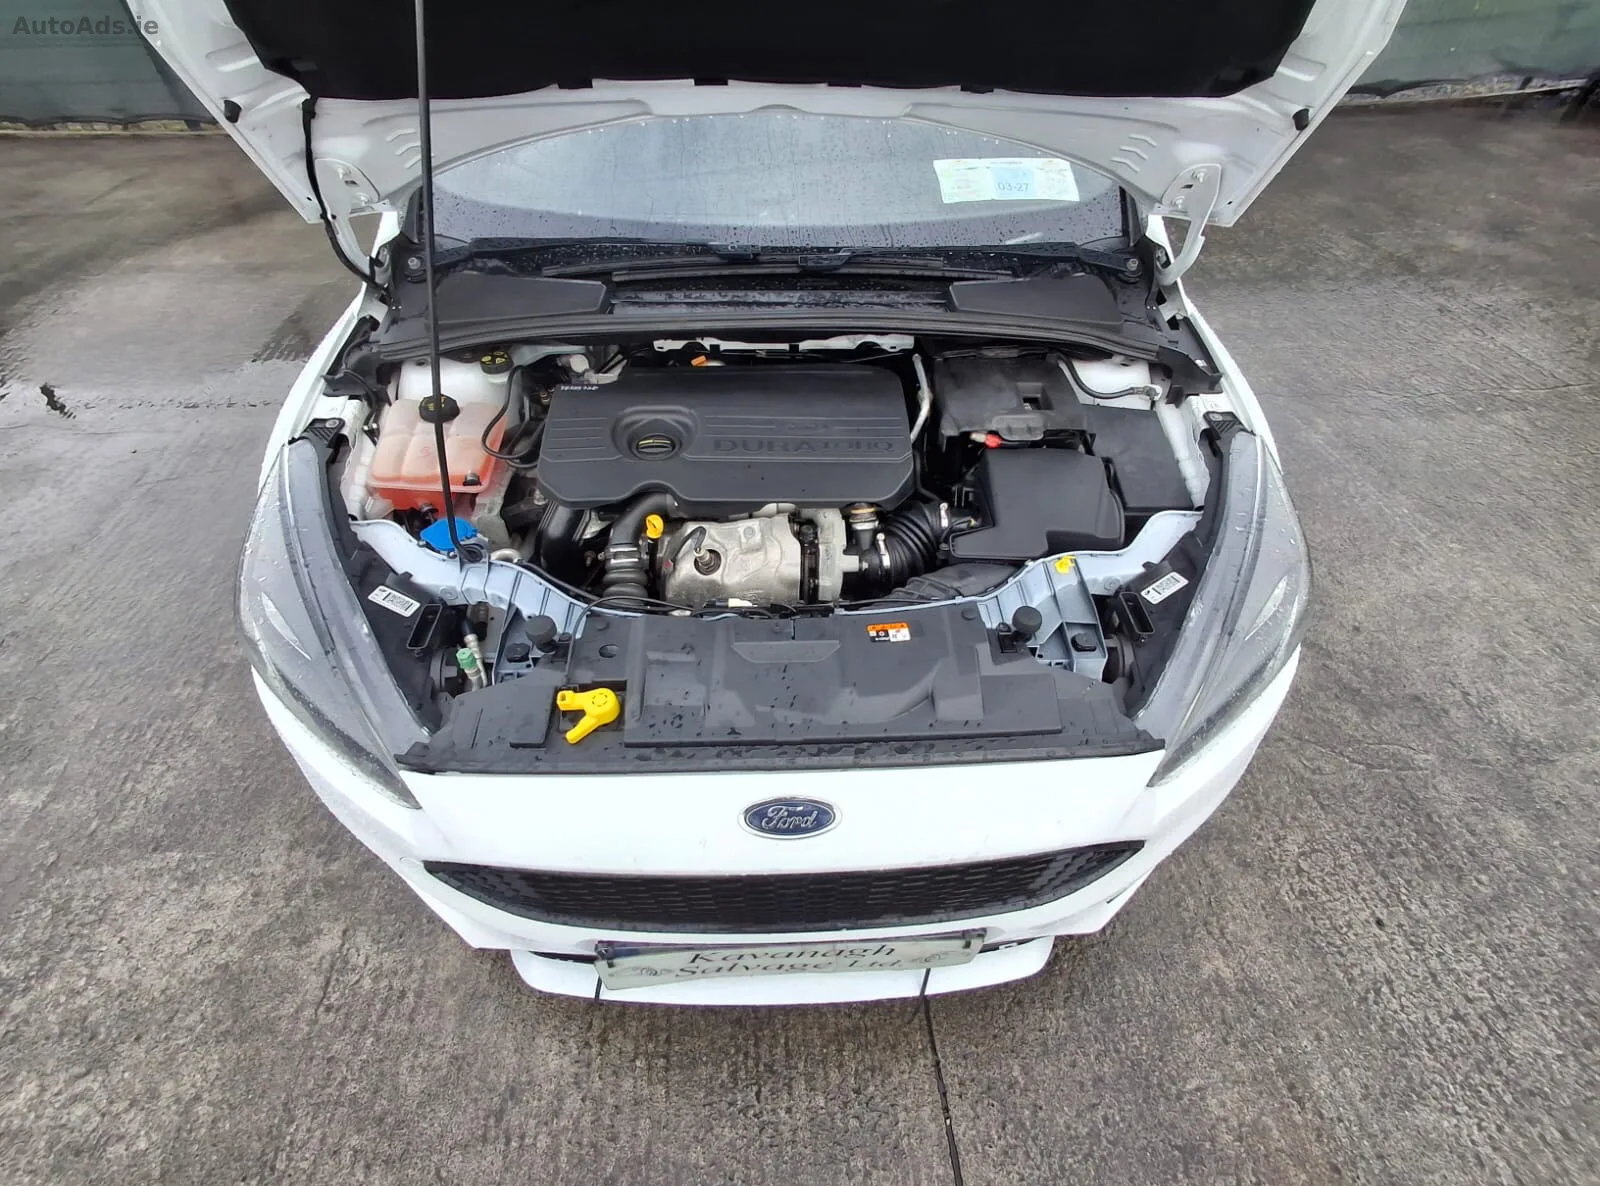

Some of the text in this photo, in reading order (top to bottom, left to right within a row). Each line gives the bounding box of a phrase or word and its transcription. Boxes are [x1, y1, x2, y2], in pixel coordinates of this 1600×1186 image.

[761, 805, 818, 829] Ford
[689, 944, 895, 963] Kavanagh
[675, 961, 832, 977] Salvage
